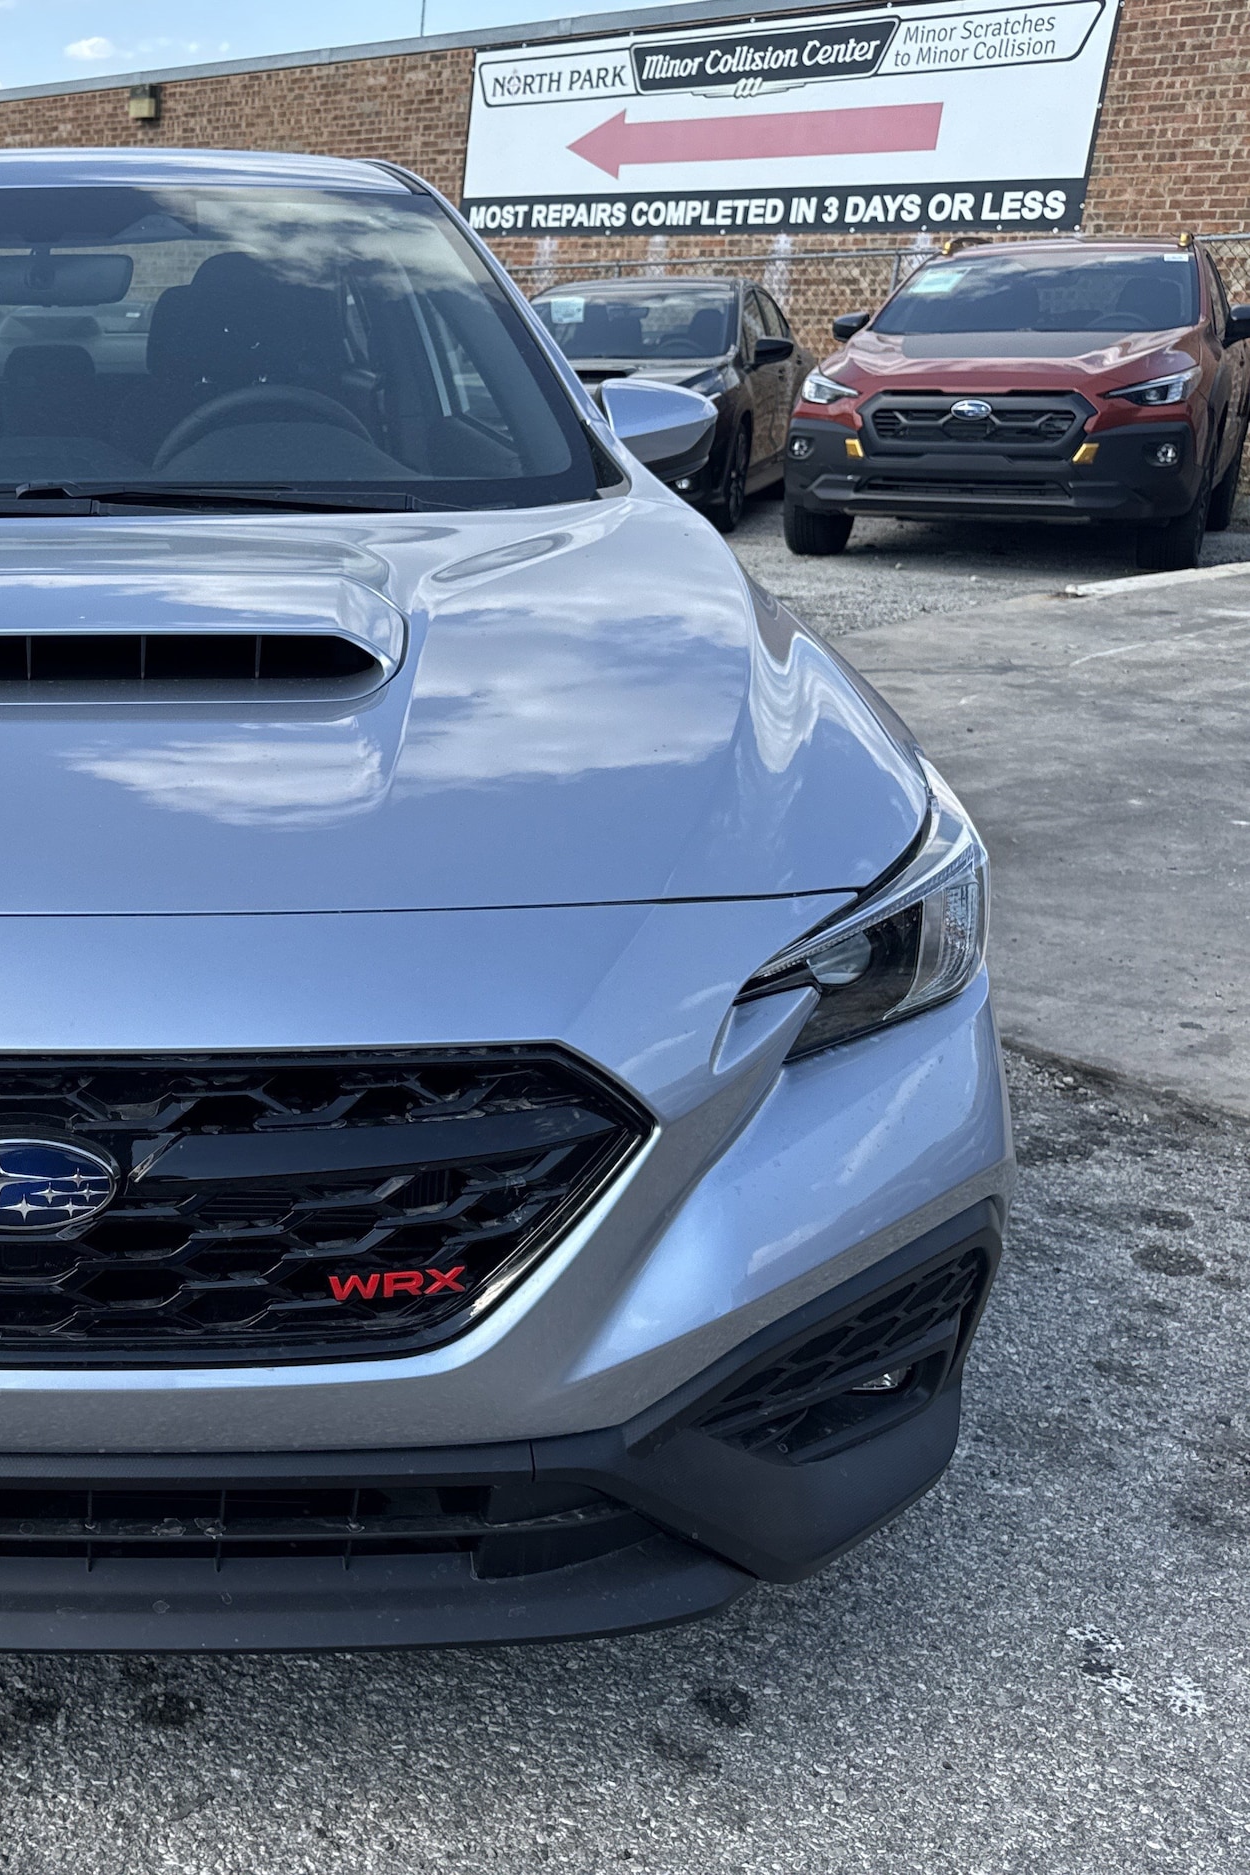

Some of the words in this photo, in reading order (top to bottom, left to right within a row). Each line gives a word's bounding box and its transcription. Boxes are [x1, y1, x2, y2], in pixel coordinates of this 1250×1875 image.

[902, 26, 957, 45] Minor
[960, 13, 1056, 40] Scratches
[642, 55, 704, 80] Minor
[705, 46, 798, 75] Collision
[802, 39, 881, 66] Center
[894, 49, 911, 67] to
[915, 47, 969, 65] Minor
[973, 38, 1056, 60] Collision
[492, 71, 563, 97] NORTH
[568, 65, 629, 91] PARK
[468, 204, 529, 230] MOST
[531, 203, 627, 228] REPAIRS
[631, 198, 785, 226] COMPLETED
[789, 197, 817, 224] IN
[822, 196, 839, 223] 3
[844, 194, 922, 222] DAYS
[927, 193, 975, 222] OR
[980, 190, 1067, 221] LESS
[328, 1265, 467, 1303] WRX
